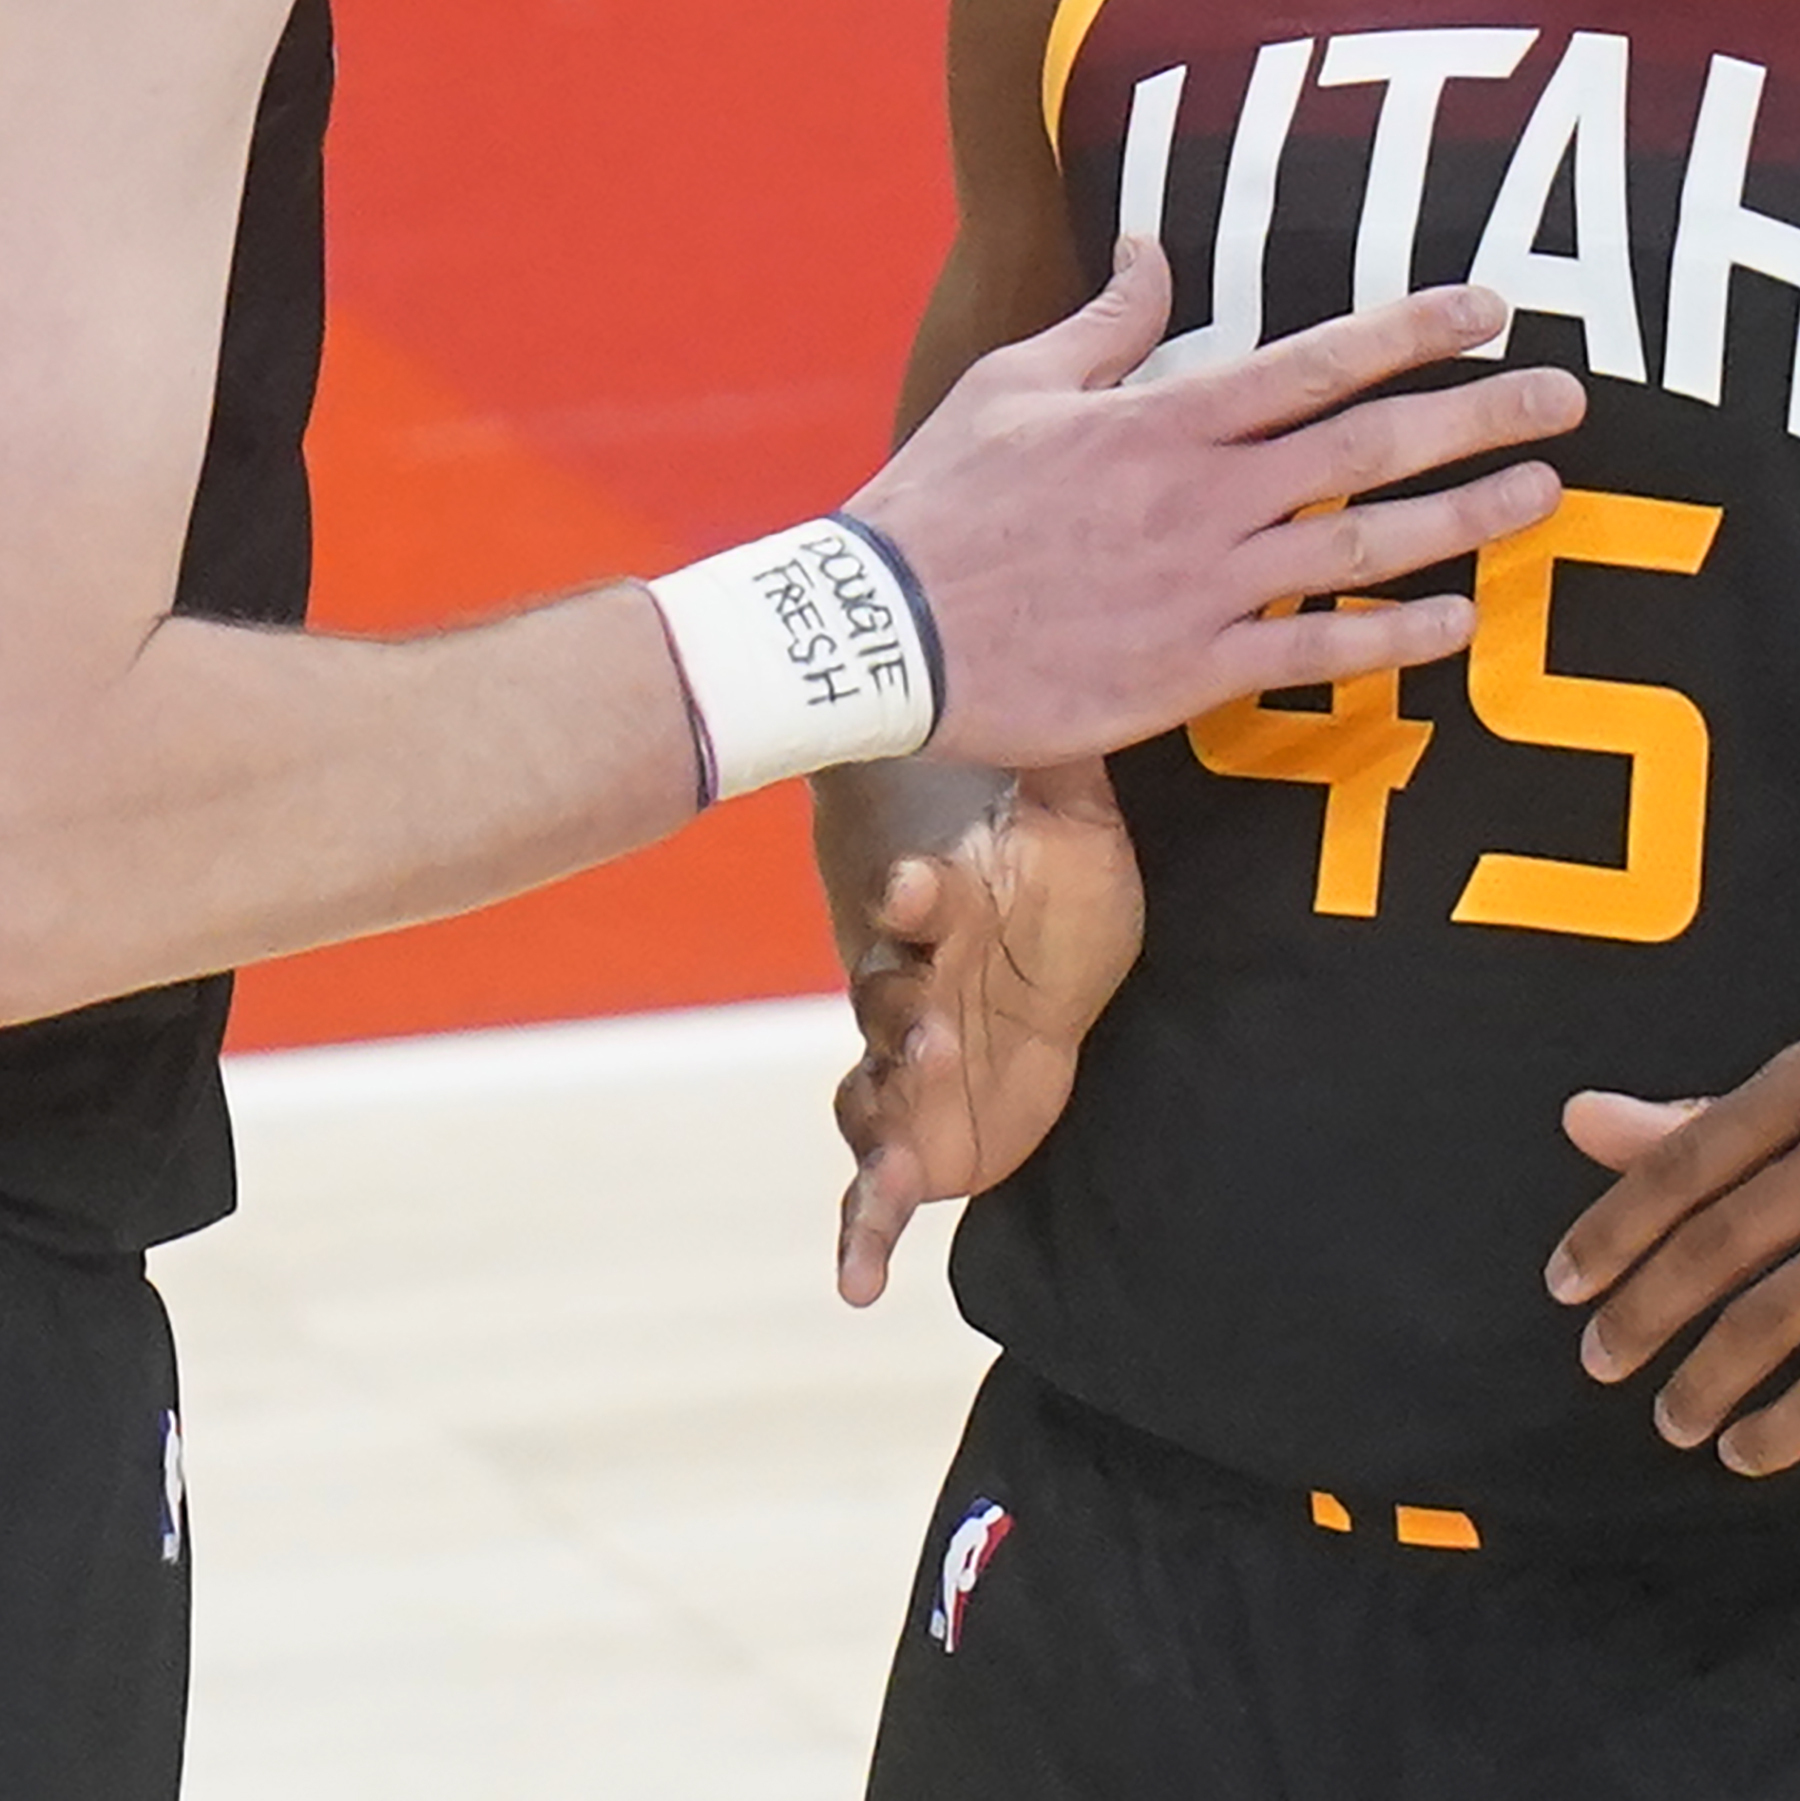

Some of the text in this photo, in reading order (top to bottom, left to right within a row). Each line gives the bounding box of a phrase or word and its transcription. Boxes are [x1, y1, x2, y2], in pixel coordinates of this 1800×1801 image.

[752, 559, 861, 706] FRESH
[799, 535, 910, 702] DOUGIE
[1185, 487, 1725, 944] 45
